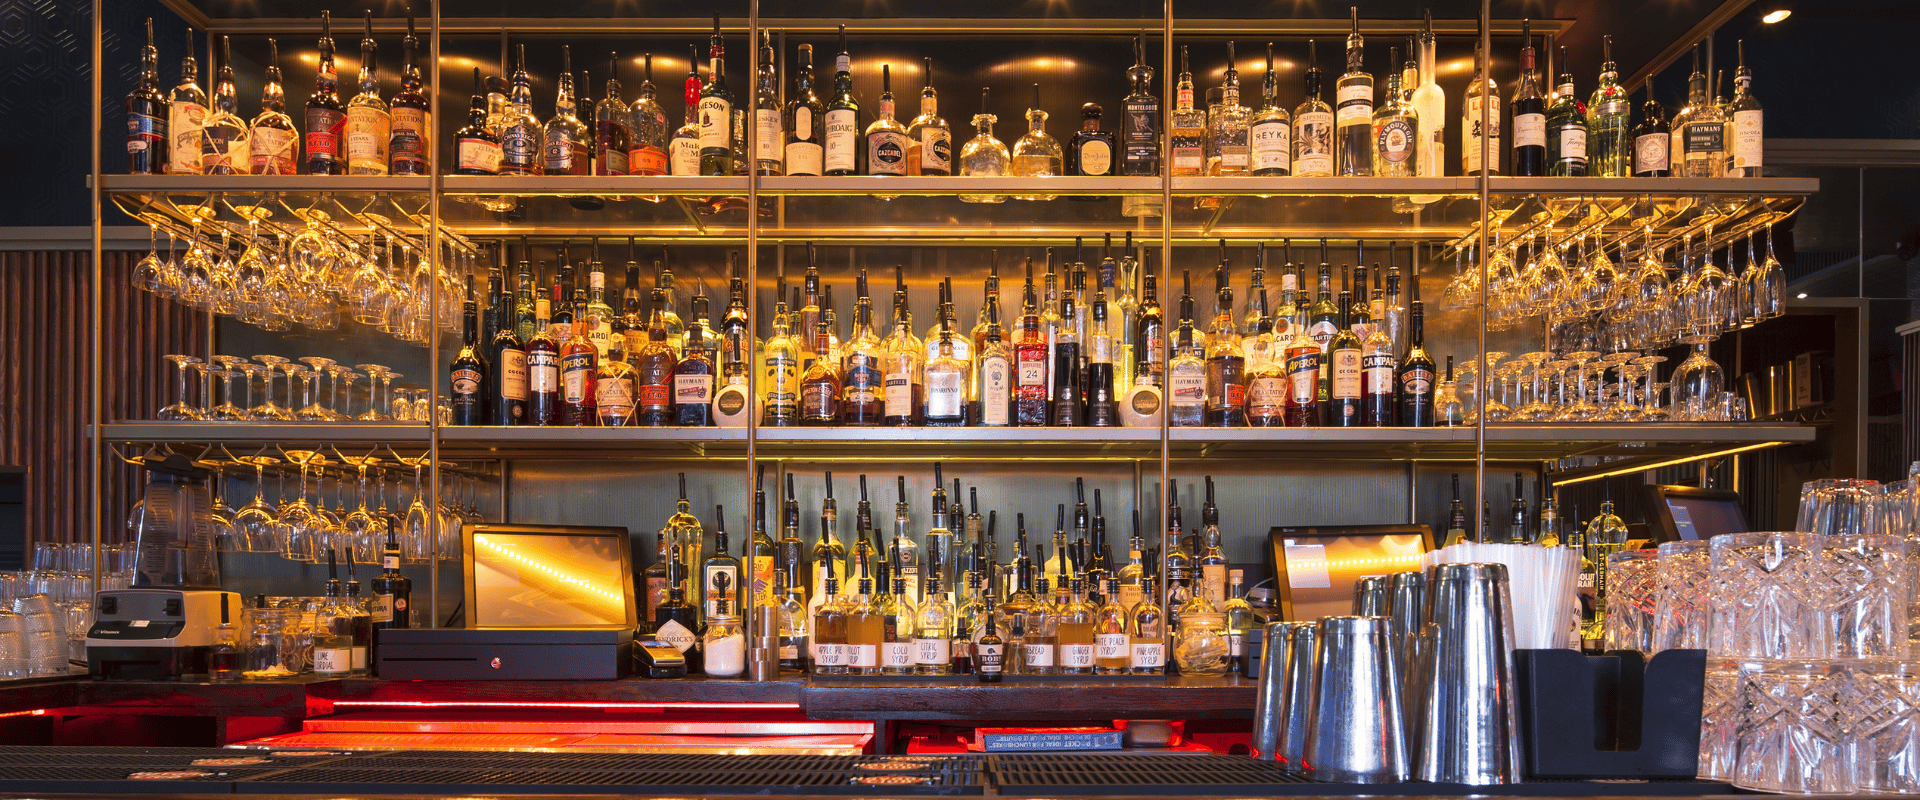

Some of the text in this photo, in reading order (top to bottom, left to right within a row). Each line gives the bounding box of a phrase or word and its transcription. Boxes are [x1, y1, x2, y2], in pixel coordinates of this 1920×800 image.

[1255, 131, 1288, 141] REYKA
[1380, 122, 1407, 146] PLYMOUTH
[1289, 359, 1318, 373] APEROL
[1026, 370, 1038, 379] 24
[1109, 637, 1124, 646] PEACH
[893, 646, 908, 655] COCO
[1072, 646, 1089, 655] GINGER
[1100, 647, 1117, 655] SYRUP
[1136, 647, 1161, 655] PINEAPPLE
[317, 651, 328, 660] LIME
[822, 655, 839, 664] SYRUP
[892, 655, 909, 664] SYRUP
[920, 652, 937, 661] SYRUP
[1073, 655, 1089, 664] SYRUP
[1140, 656, 1157, 664] SYRUP
